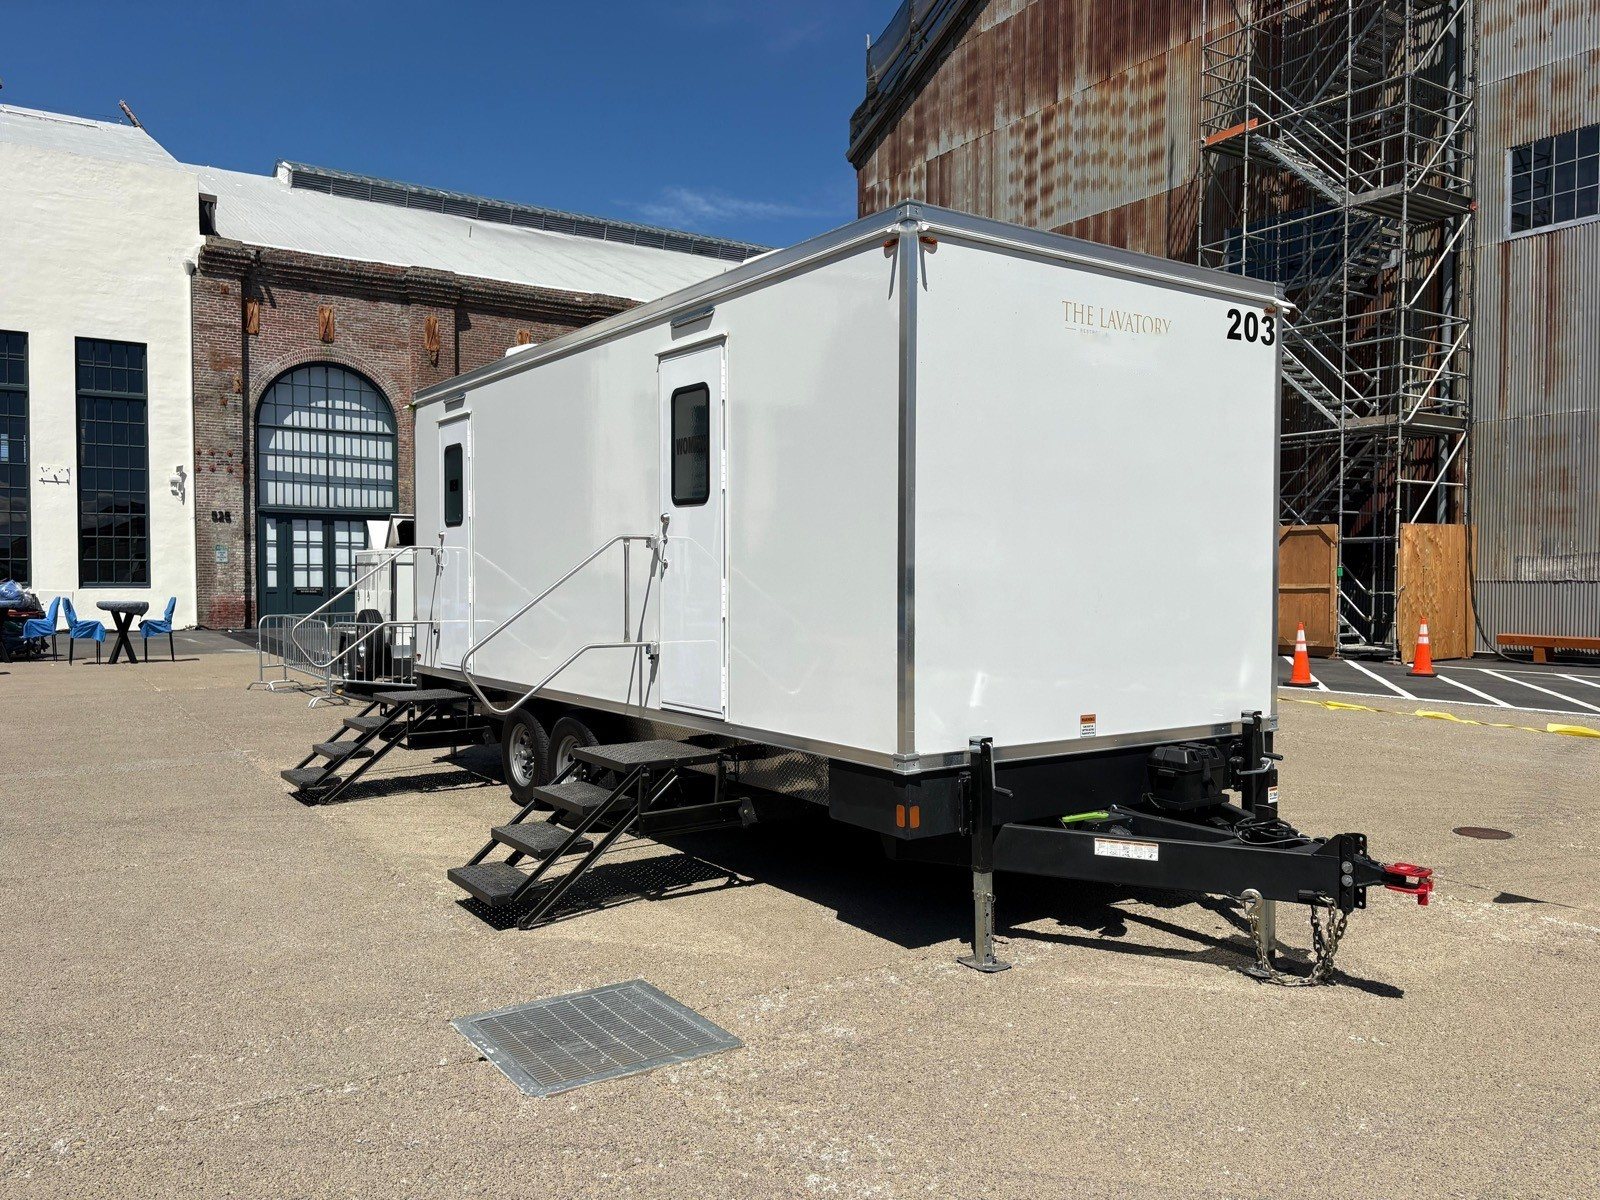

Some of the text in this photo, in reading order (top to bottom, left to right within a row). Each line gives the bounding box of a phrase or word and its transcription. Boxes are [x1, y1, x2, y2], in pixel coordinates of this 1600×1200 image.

[1062, 300, 1172, 334] THE LAVATORY
[1226, 308, 1275, 346] 203
